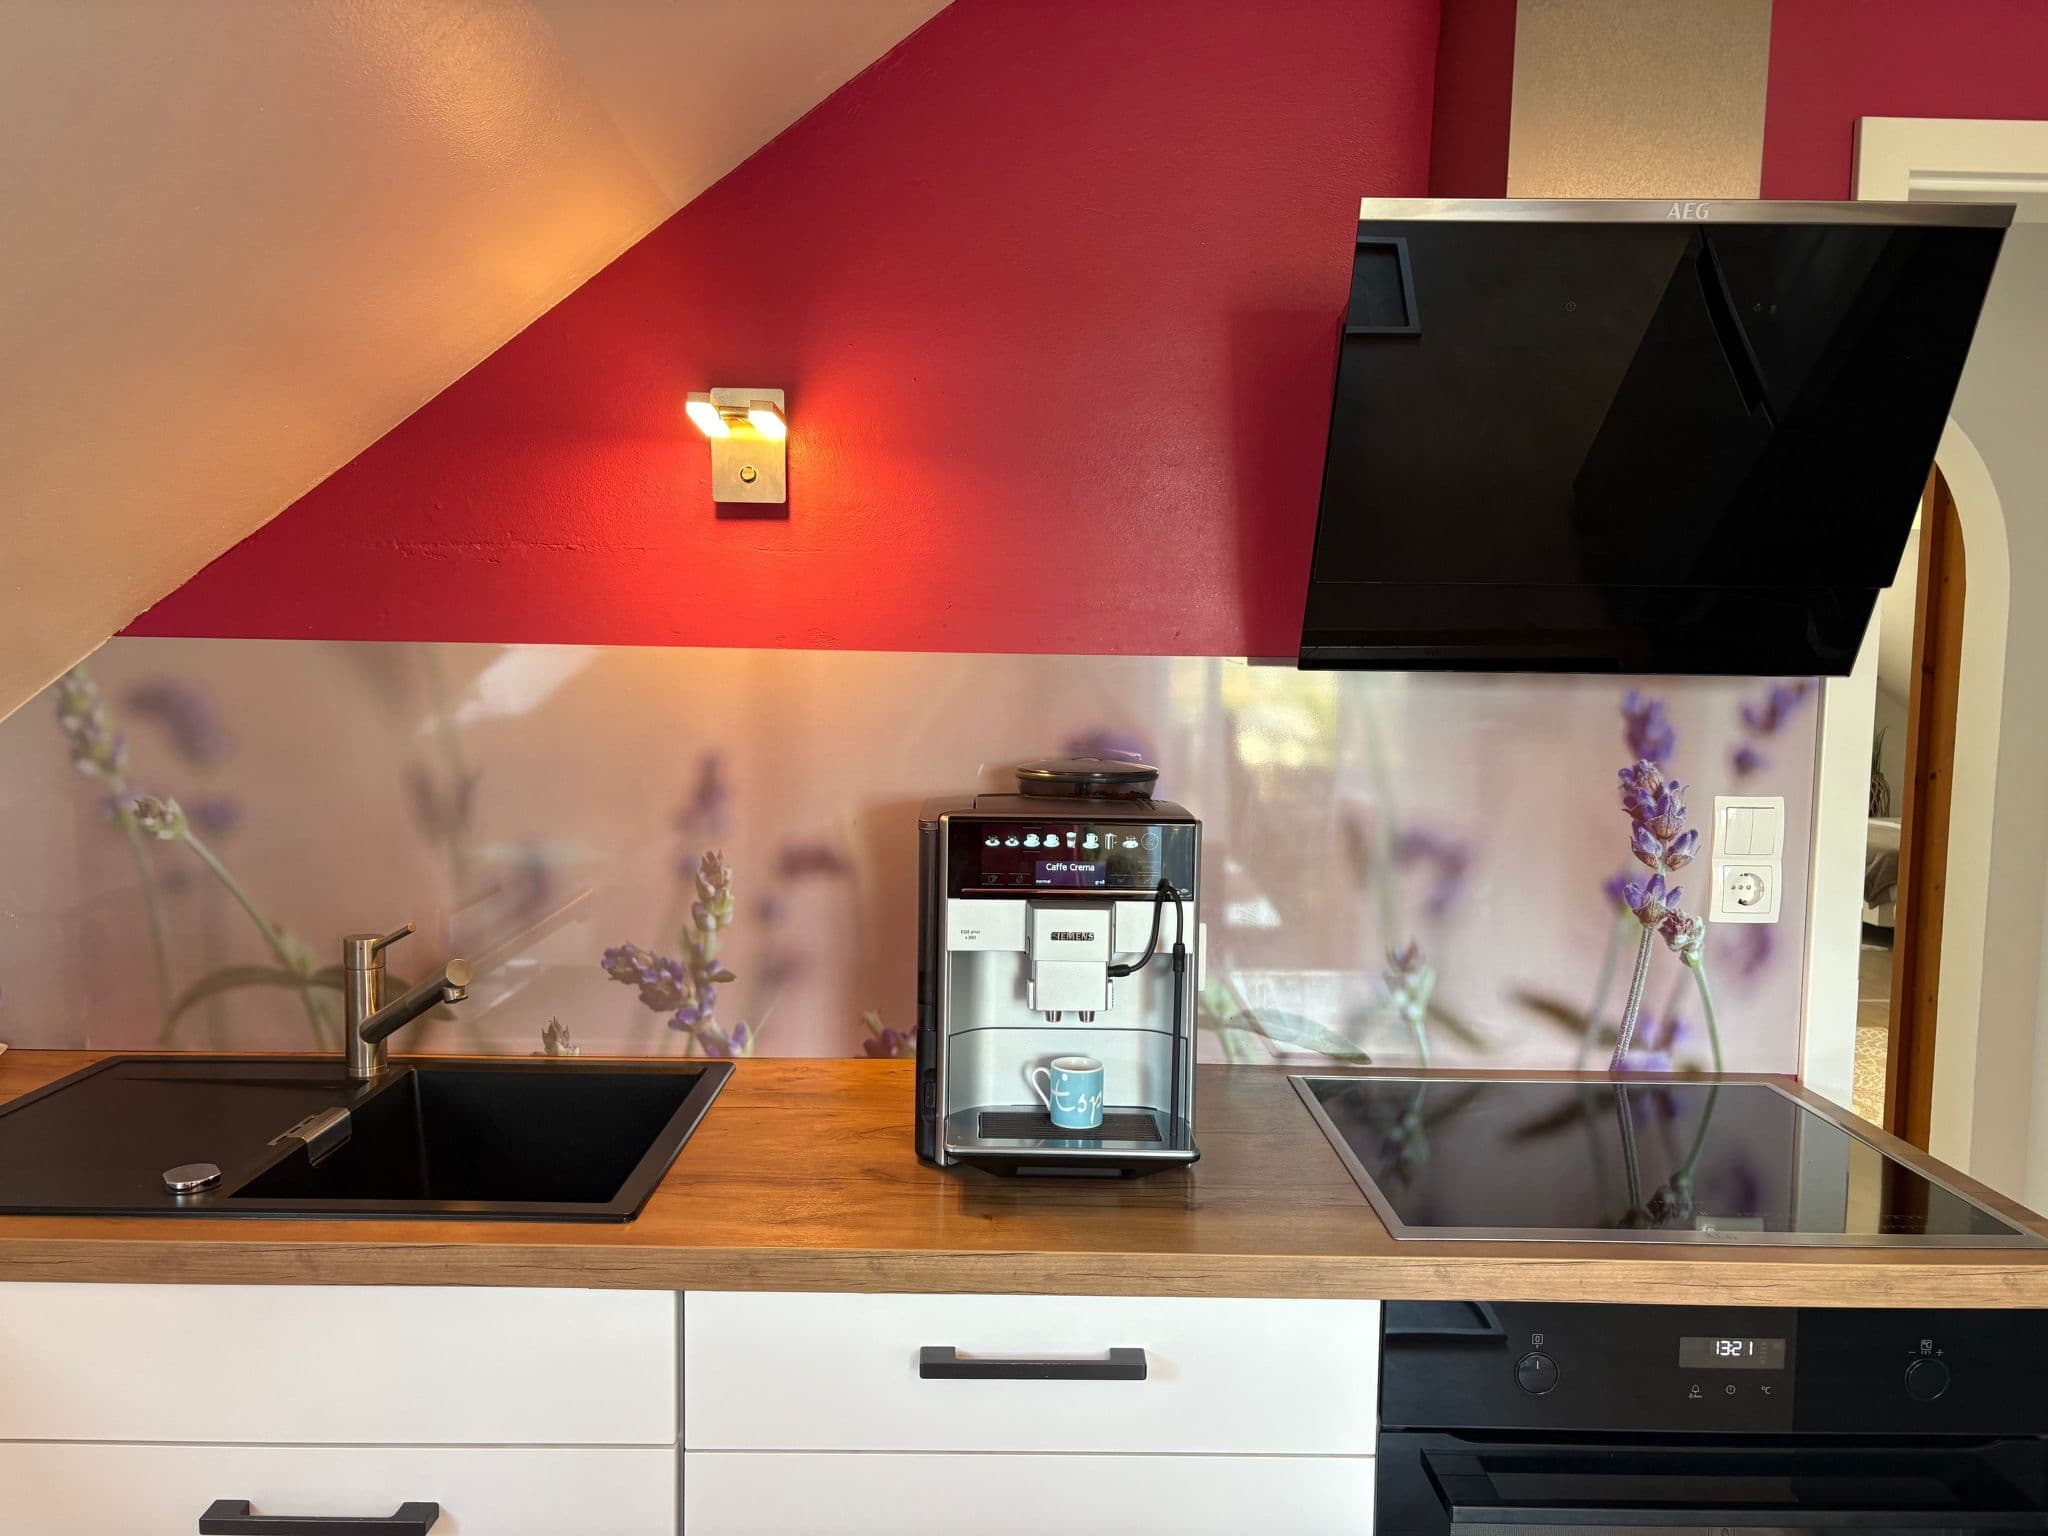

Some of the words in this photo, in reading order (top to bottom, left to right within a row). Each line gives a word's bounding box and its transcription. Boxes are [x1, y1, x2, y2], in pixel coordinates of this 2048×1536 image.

[1666, 202, 1710, 220] AEG
[1069, 863, 1095, 872] Crema
[1051, 932, 1094, 941] SIEMENS
